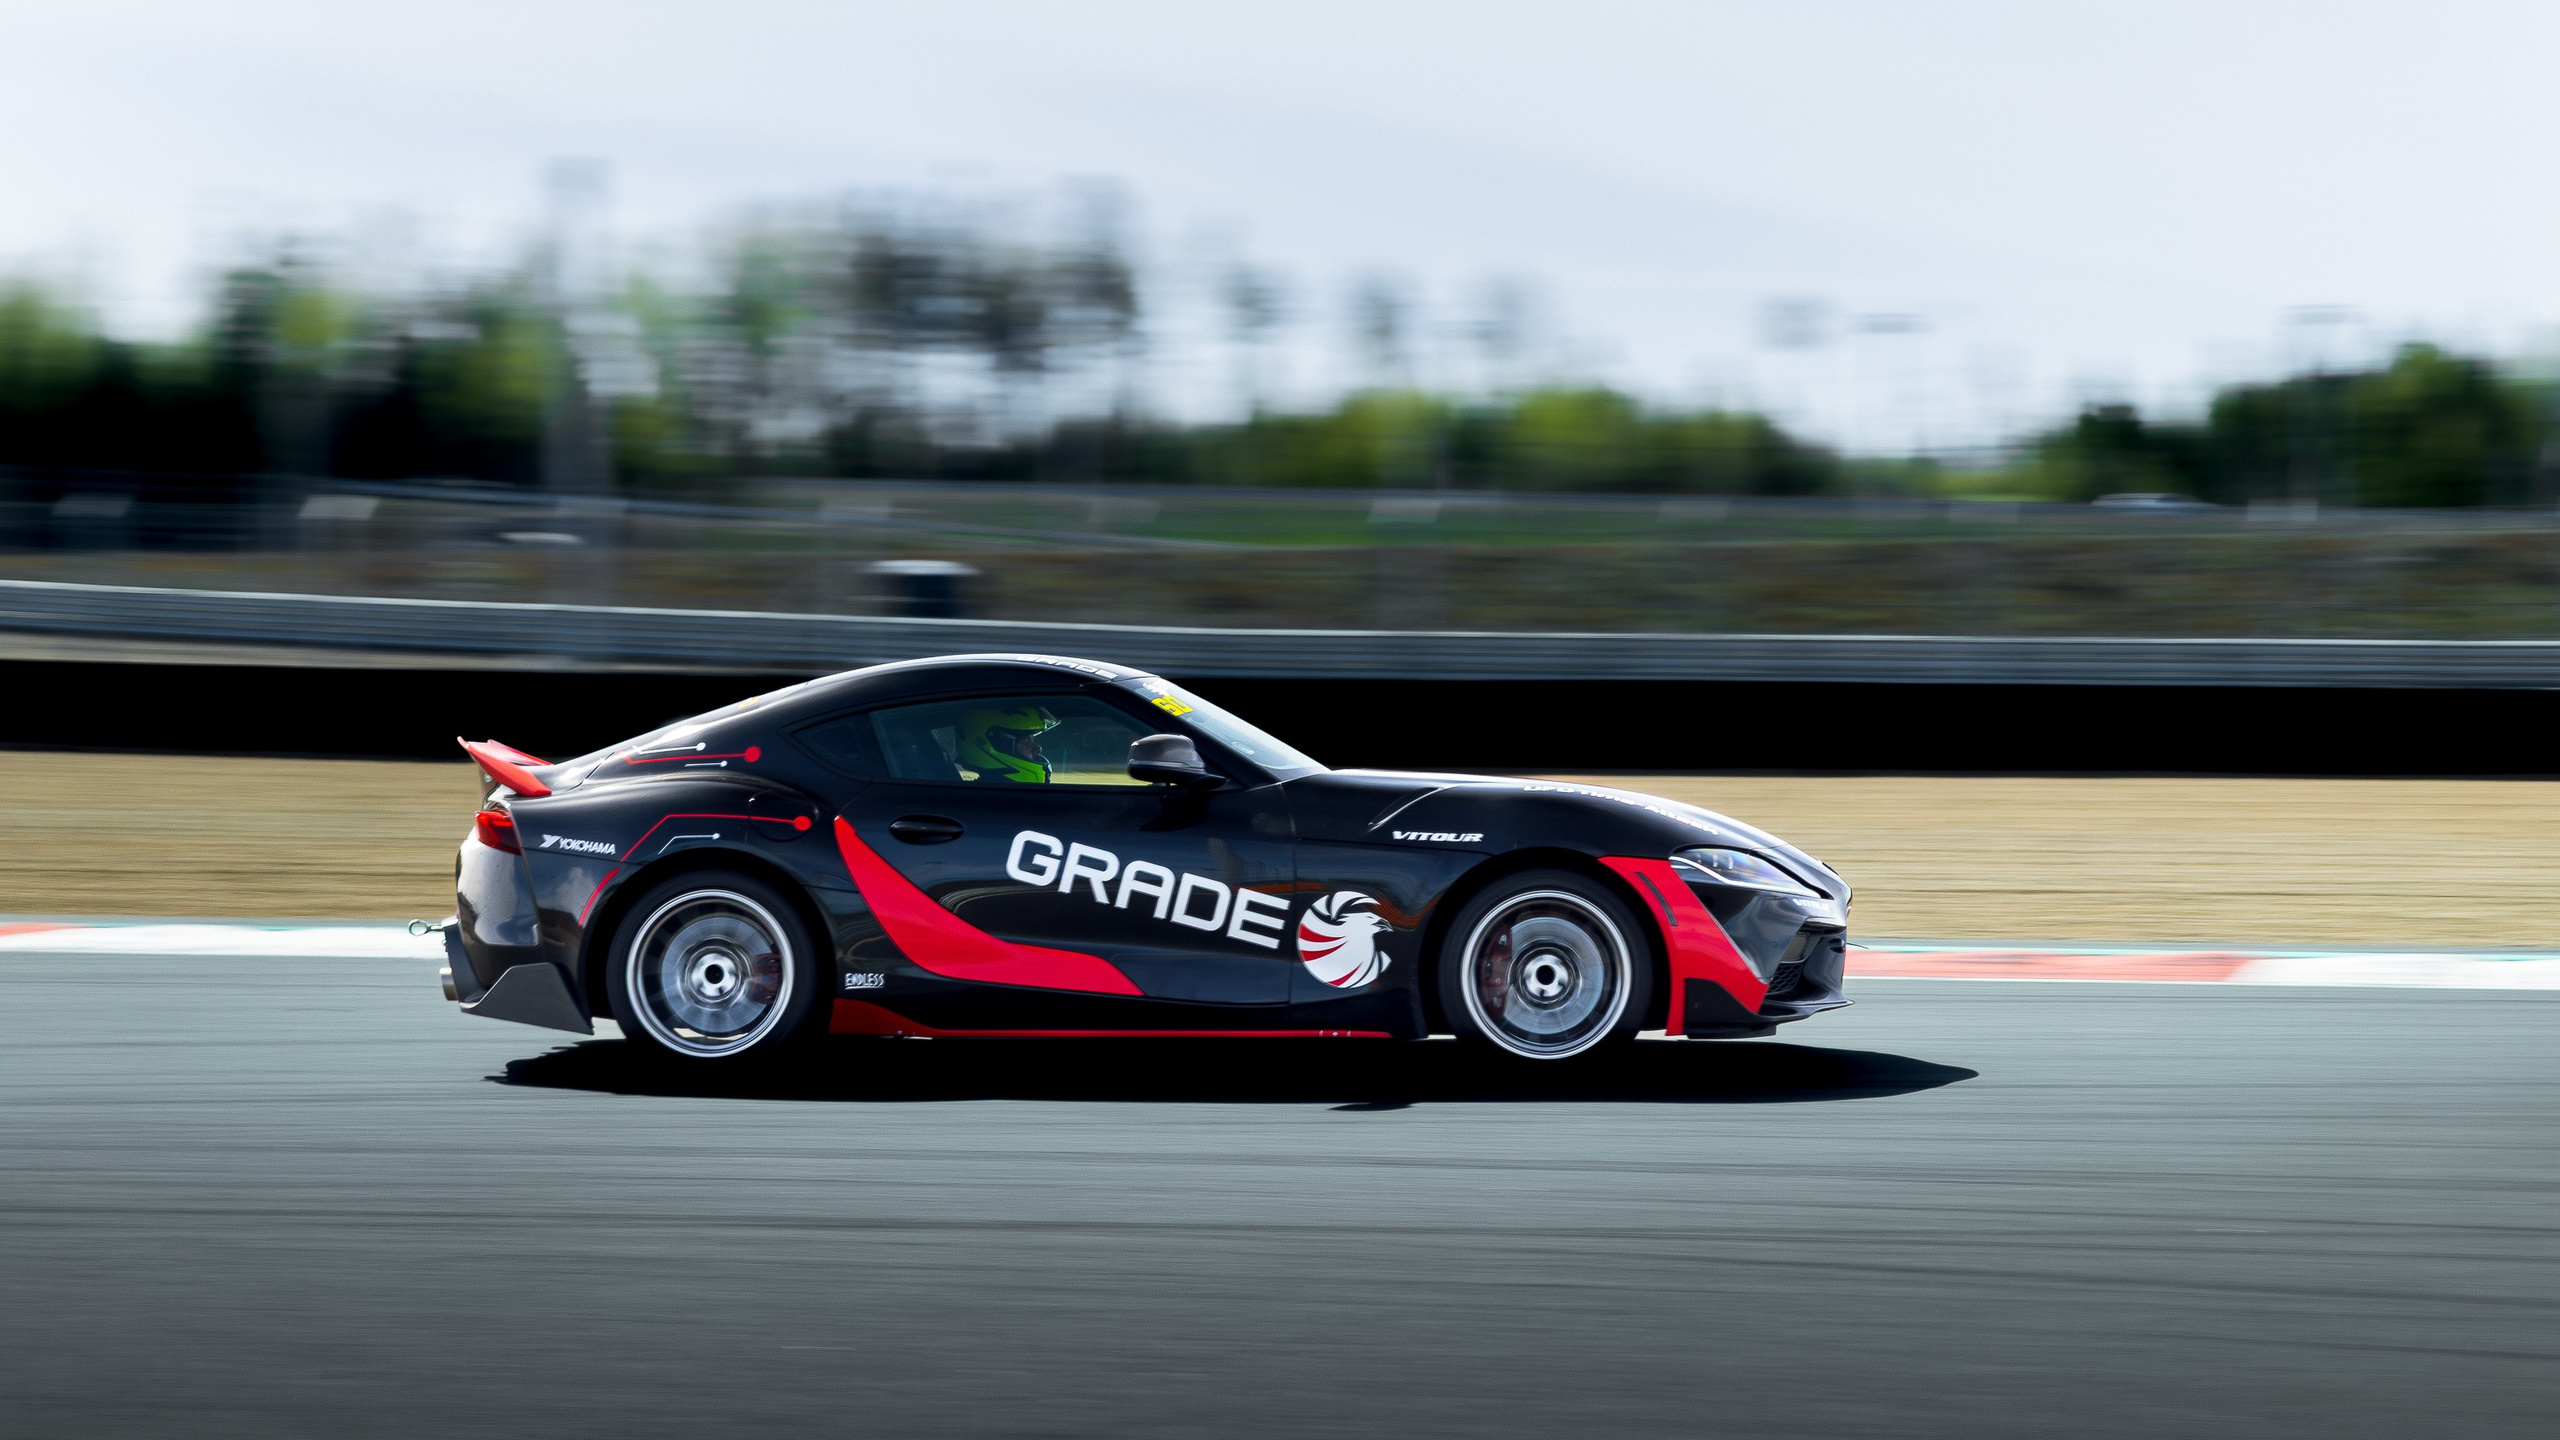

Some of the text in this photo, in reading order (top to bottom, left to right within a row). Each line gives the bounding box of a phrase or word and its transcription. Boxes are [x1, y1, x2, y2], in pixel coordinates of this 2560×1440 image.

[1392, 830, 1484, 842] VITOUR
[559, 837, 616, 855] YOKOHAMA
[1006, 830, 1291, 949] GRADE
[845, 973, 885, 988] ENDLESS
